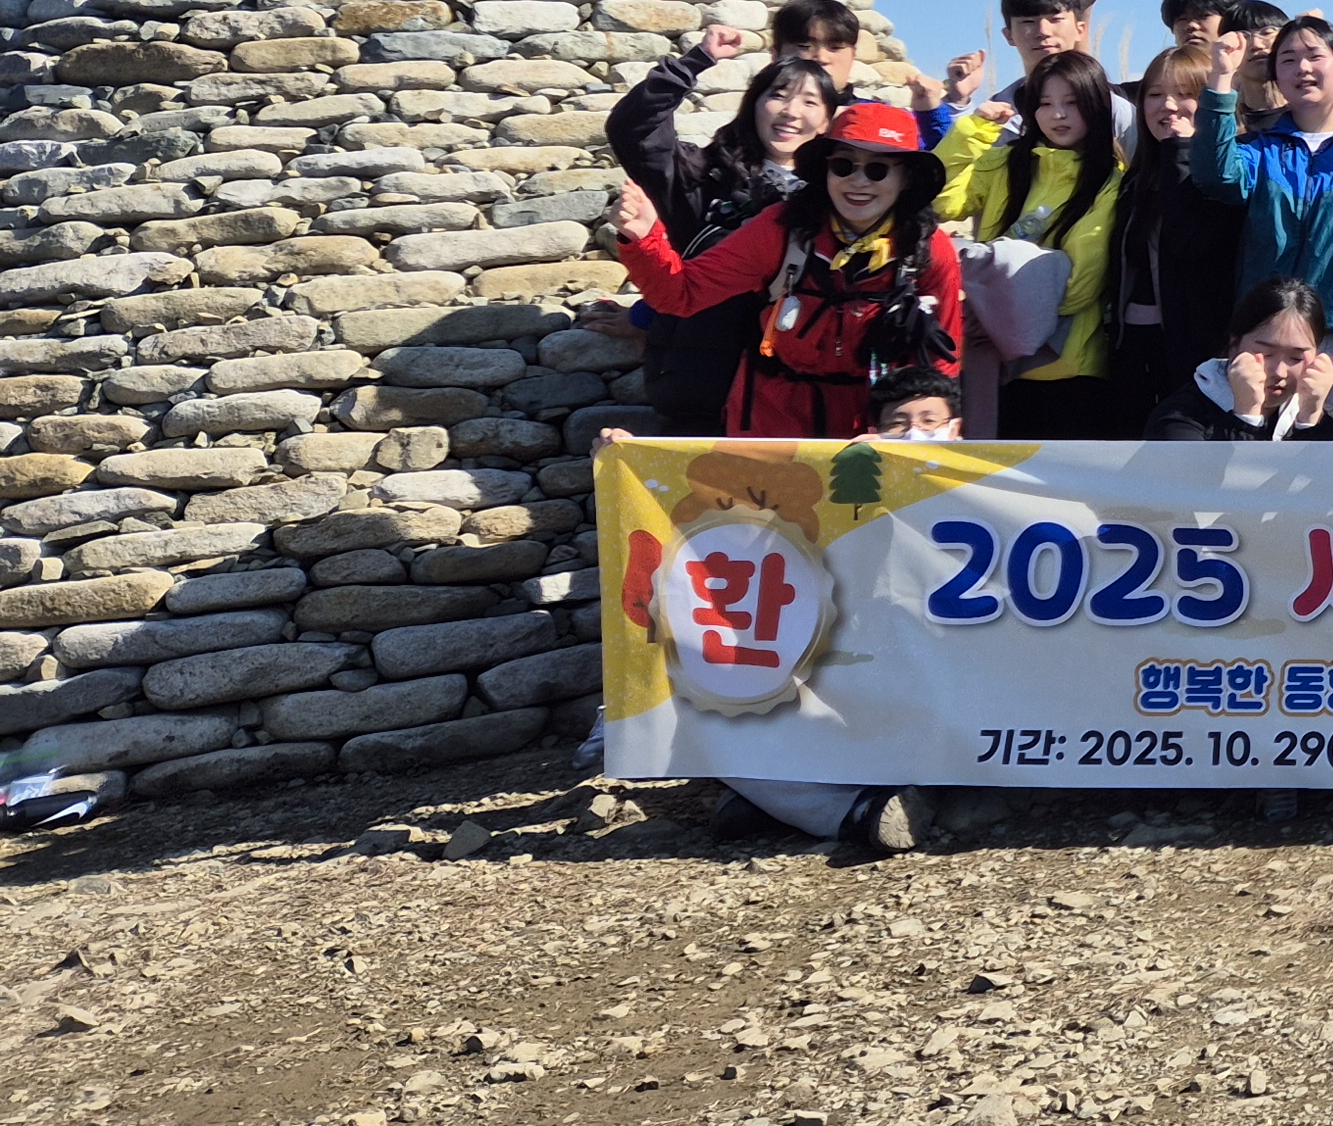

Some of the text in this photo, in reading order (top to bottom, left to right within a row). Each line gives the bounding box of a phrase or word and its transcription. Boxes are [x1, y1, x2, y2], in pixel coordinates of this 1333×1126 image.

[928, 520, 1245, 621] 2025
[685, 551, 795, 667] 환
[1140, 664, 1269, 711] 행복한
[977, 729, 1067, 766] 기간:
[1078, 730, 1194, 767] 2025.
[1207, 730, 1260, 767] 10.
